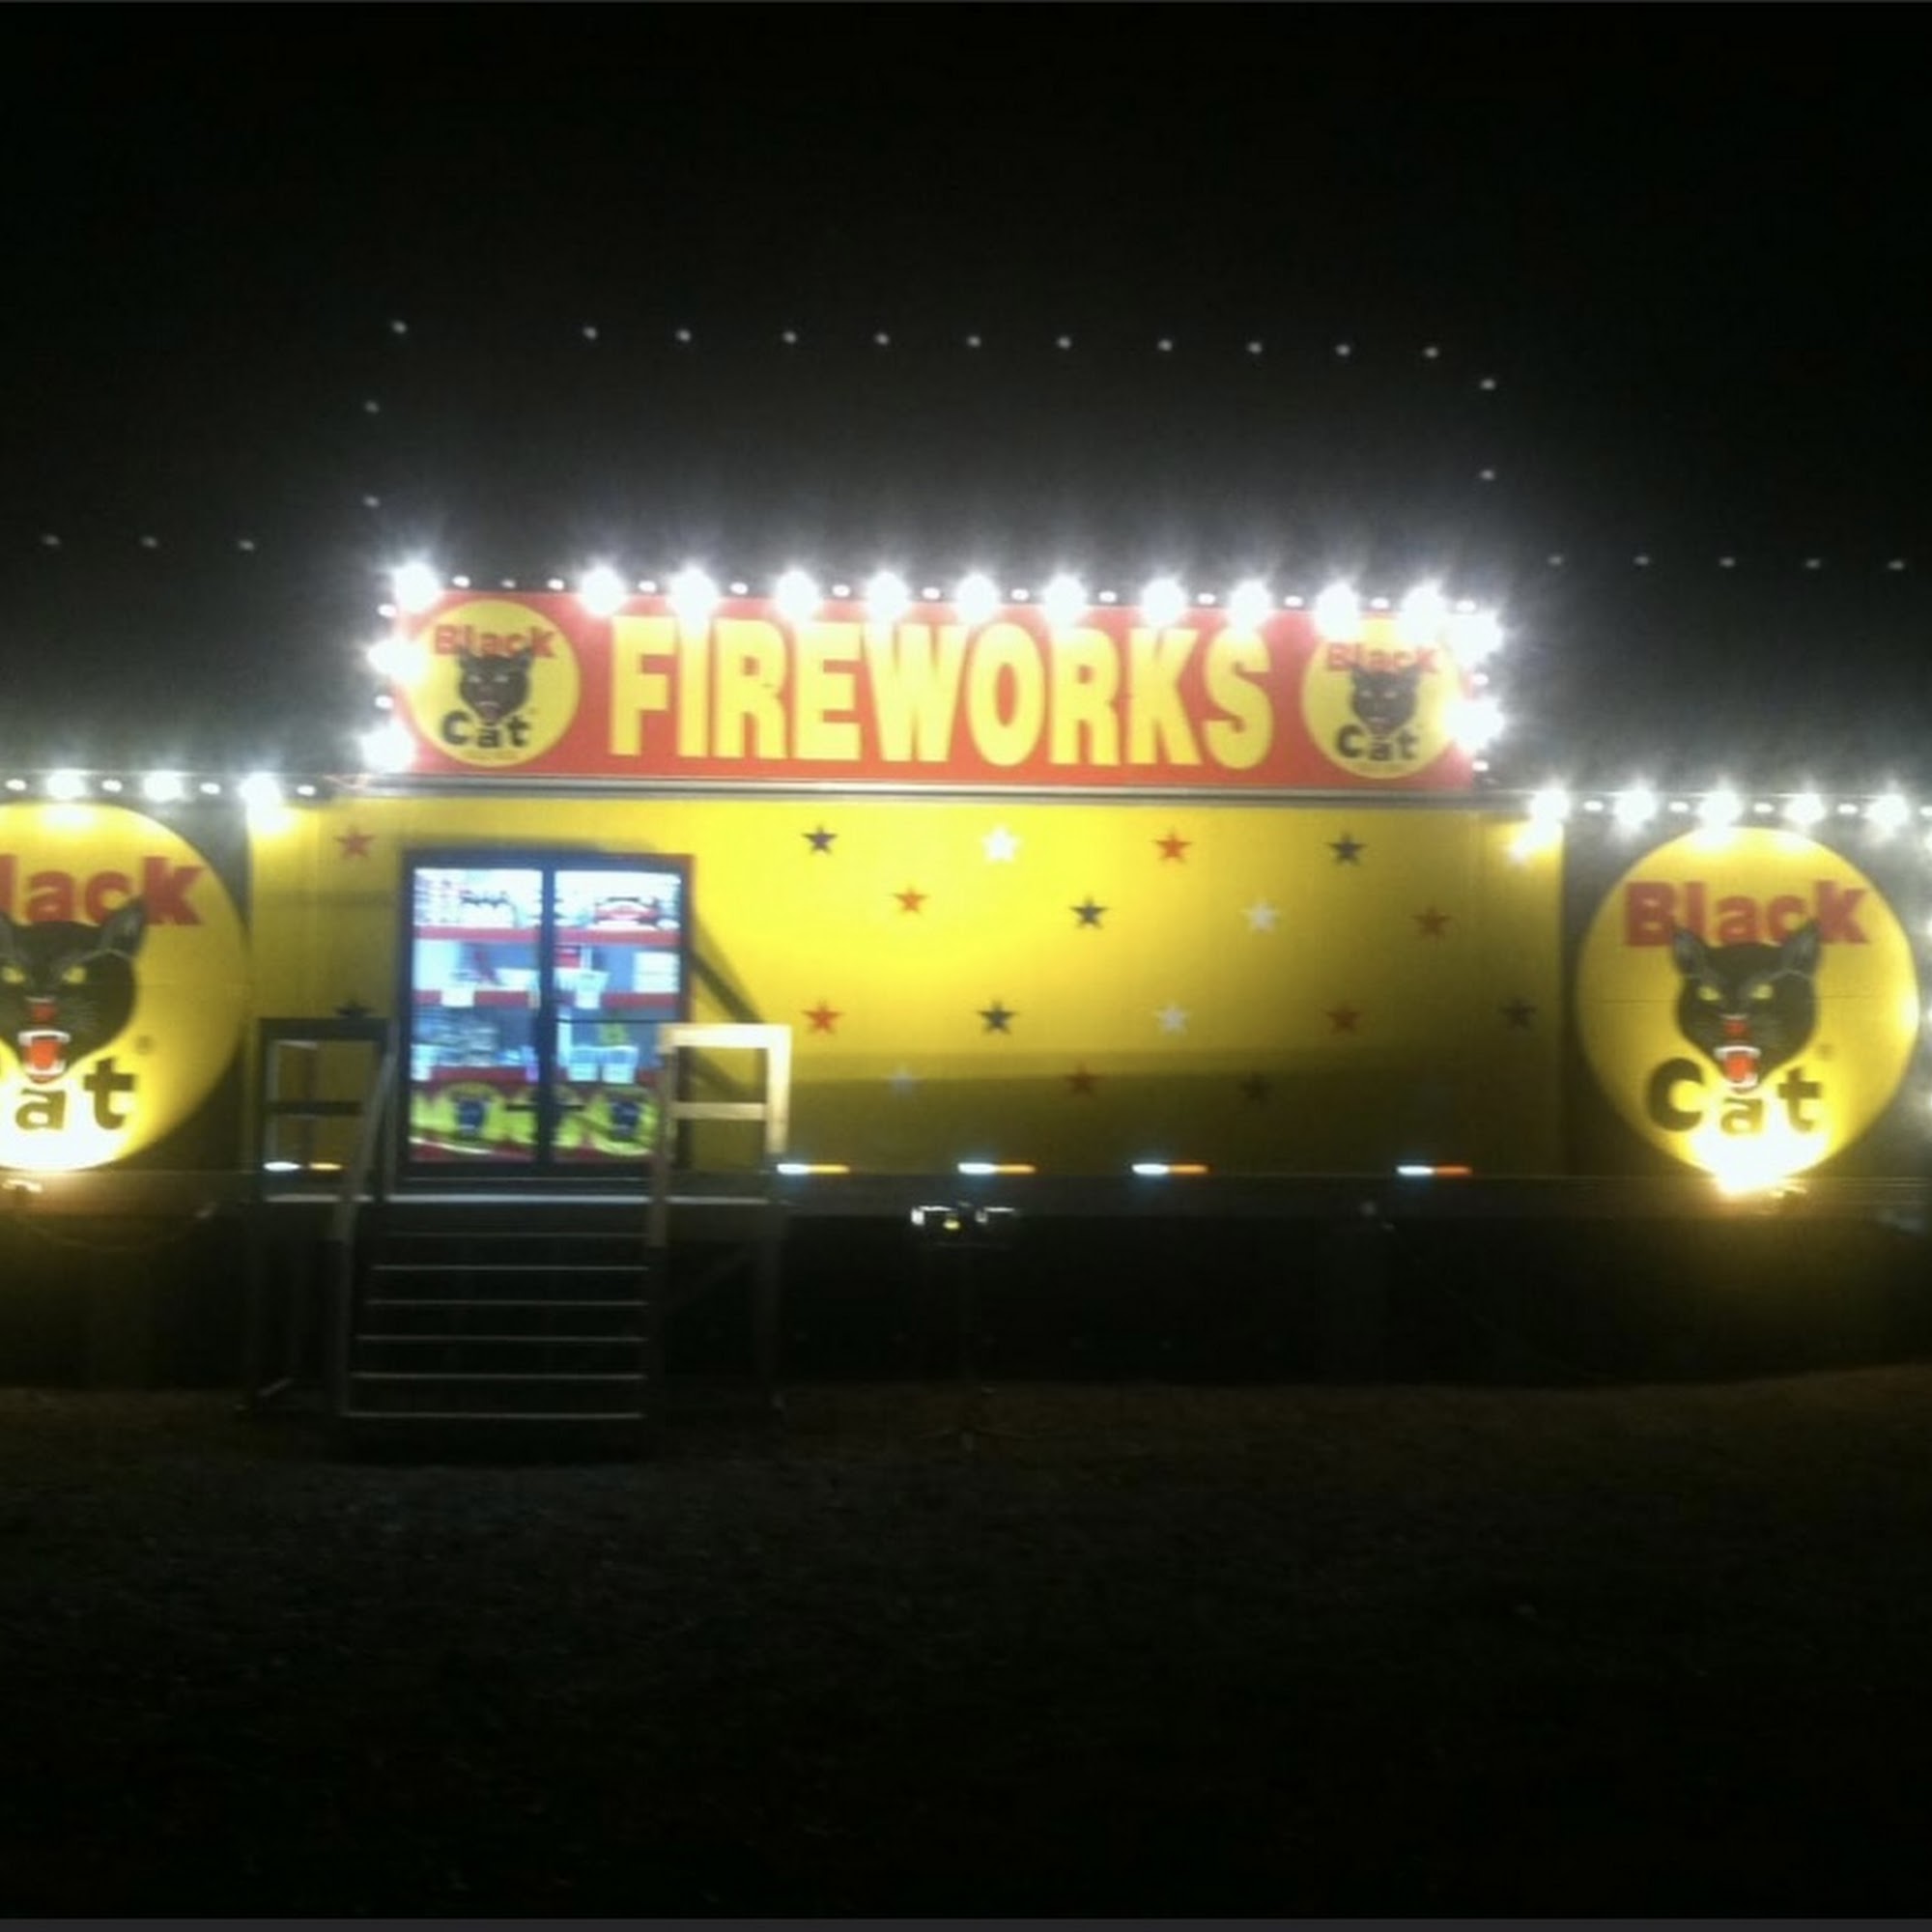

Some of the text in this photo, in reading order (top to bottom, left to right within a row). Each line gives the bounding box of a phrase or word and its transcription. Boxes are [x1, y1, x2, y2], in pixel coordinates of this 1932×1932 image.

[435, 624, 554, 658] Black
[1327, 641, 1436, 673] Black
[610, 614, 1274, 769] FIREWORKS
[441, 711, 530, 749] Cat
[1336, 724, 1418, 761] Cat
[0, 854, 204, 925] lack
[1624, 881, 1869, 946] Black
[8, 1057, 135, 1131] at
[1648, 1057, 1822, 1134] Cat
